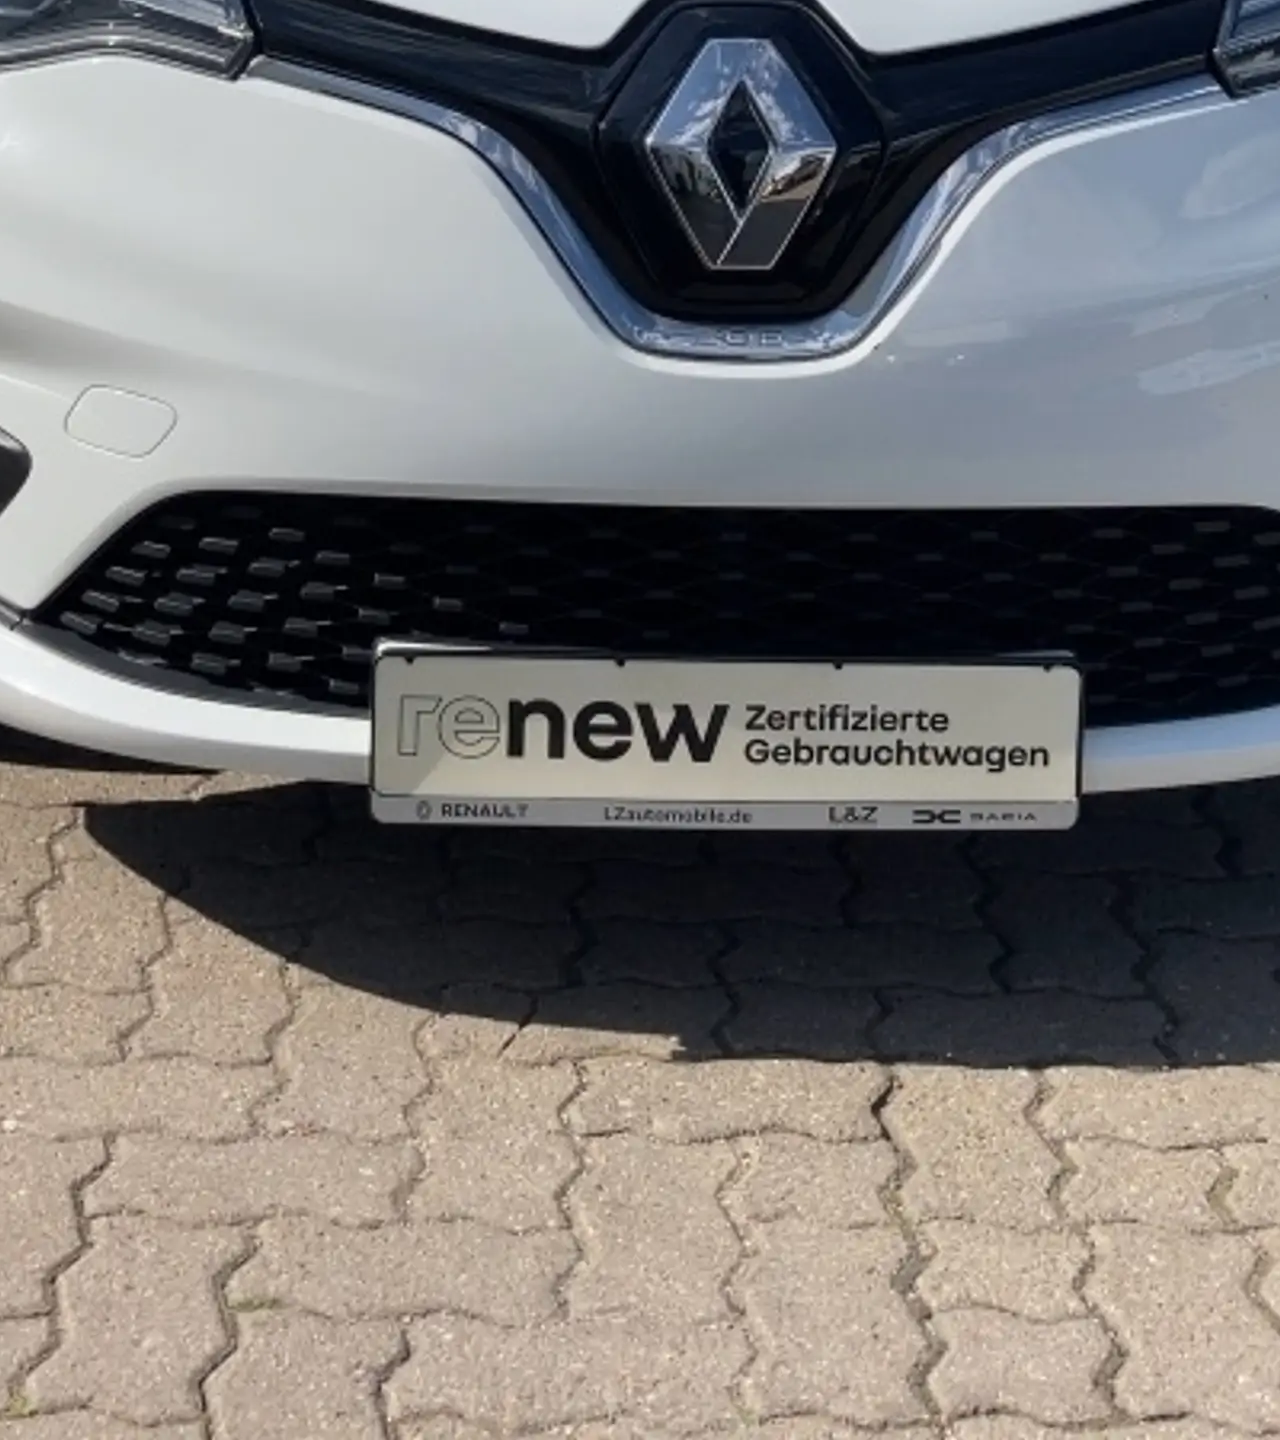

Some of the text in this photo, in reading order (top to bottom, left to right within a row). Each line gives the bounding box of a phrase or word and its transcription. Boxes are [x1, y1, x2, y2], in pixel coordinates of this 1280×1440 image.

[397, 694, 730, 763] renew
[744, 704, 950, 733] Zertifizierte
[743, 736, 1050, 773] Gebrauchtwagen
[441, 802, 530, 819] RENAULT
[603, 806, 754, 824] LZautomobile.de
[828, 806, 878, 823] L&Z
